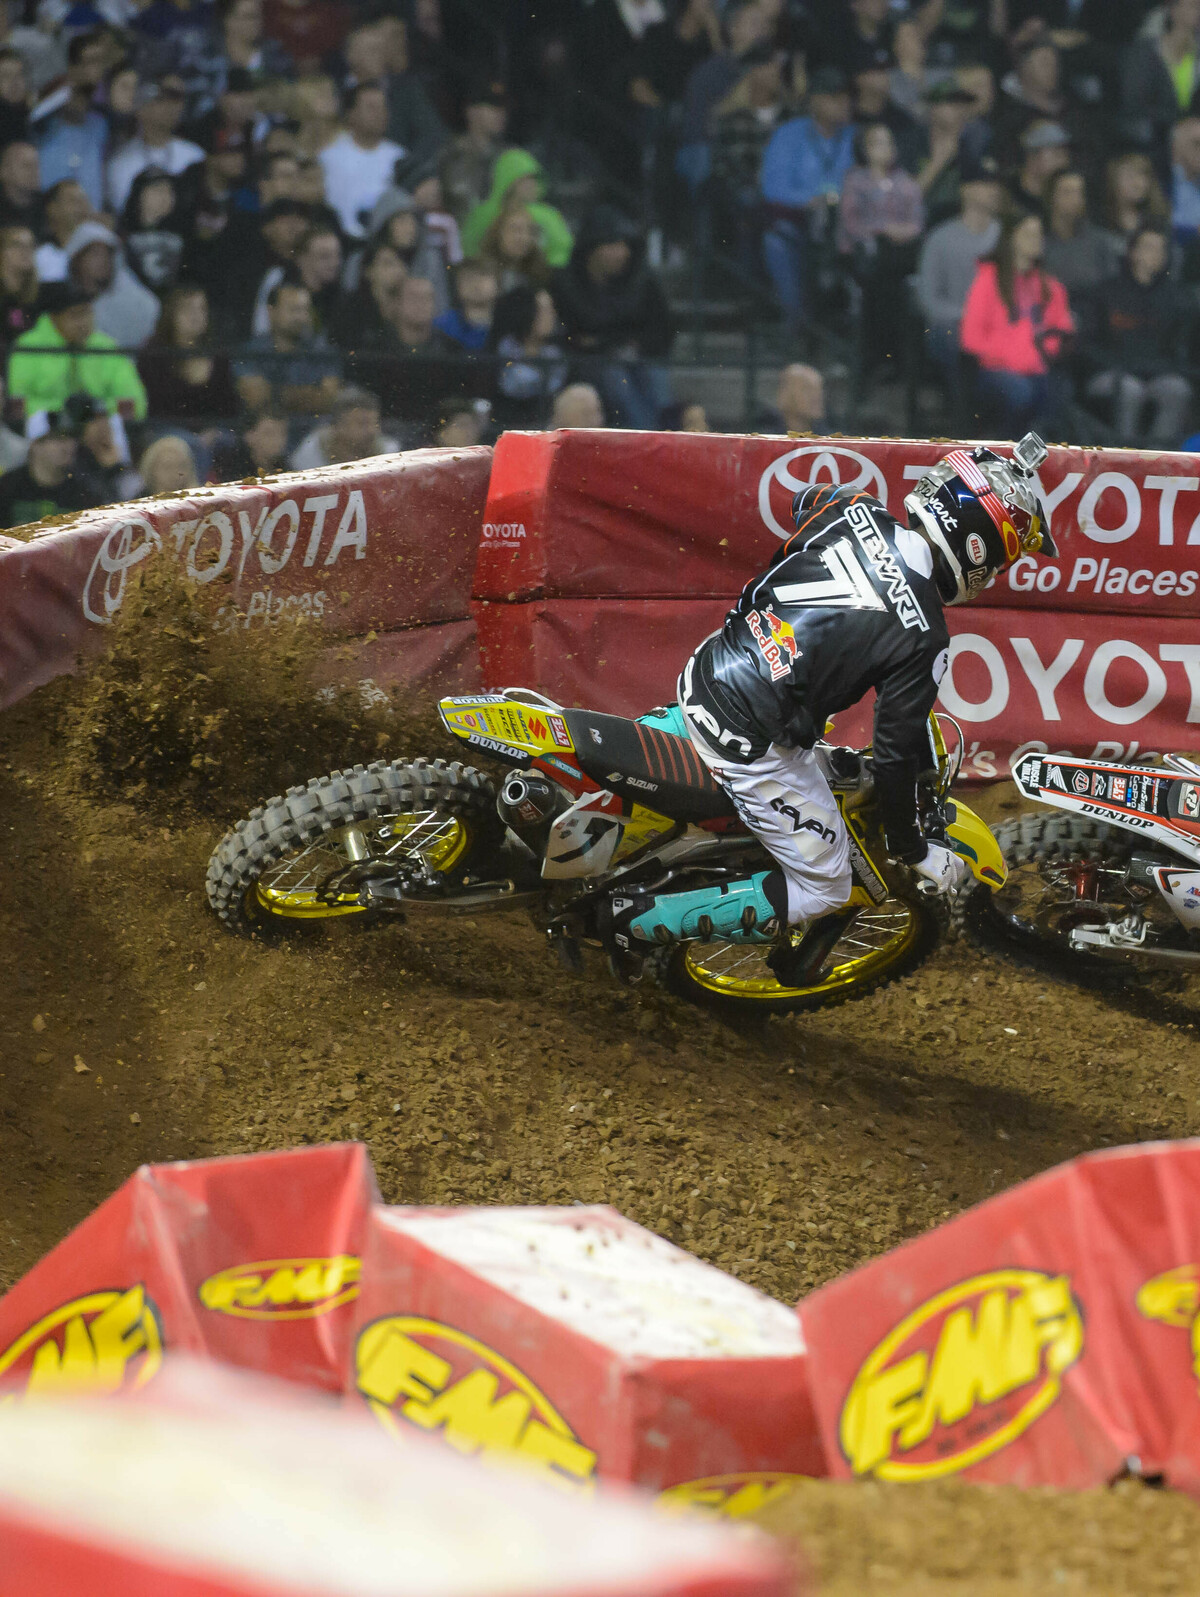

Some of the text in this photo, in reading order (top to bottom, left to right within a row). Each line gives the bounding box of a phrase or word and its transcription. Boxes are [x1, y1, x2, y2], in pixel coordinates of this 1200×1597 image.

[482, 522, 527, 538] OYOTA
[843, 501, 931, 633] STEWART
[970, 538, 983, 562] BELL
[772, 535, 889, 613] 7
[1008, 556, 1200, 597] Go Places
[468, 733, 529, 760] DUNLOP
[625, 776, 660, 793] SUZUKI
[1029, 760, 1042, 789] MUSCLE
[1131, 775, 1140, 809] GoPro
[1079, 803, 1156, 830] DUNLOP
[28, 1284, 148, 1396] MF
[850, 1273, 1076, 1473] FMF
[357, 1327, 598, 1480] FMF
